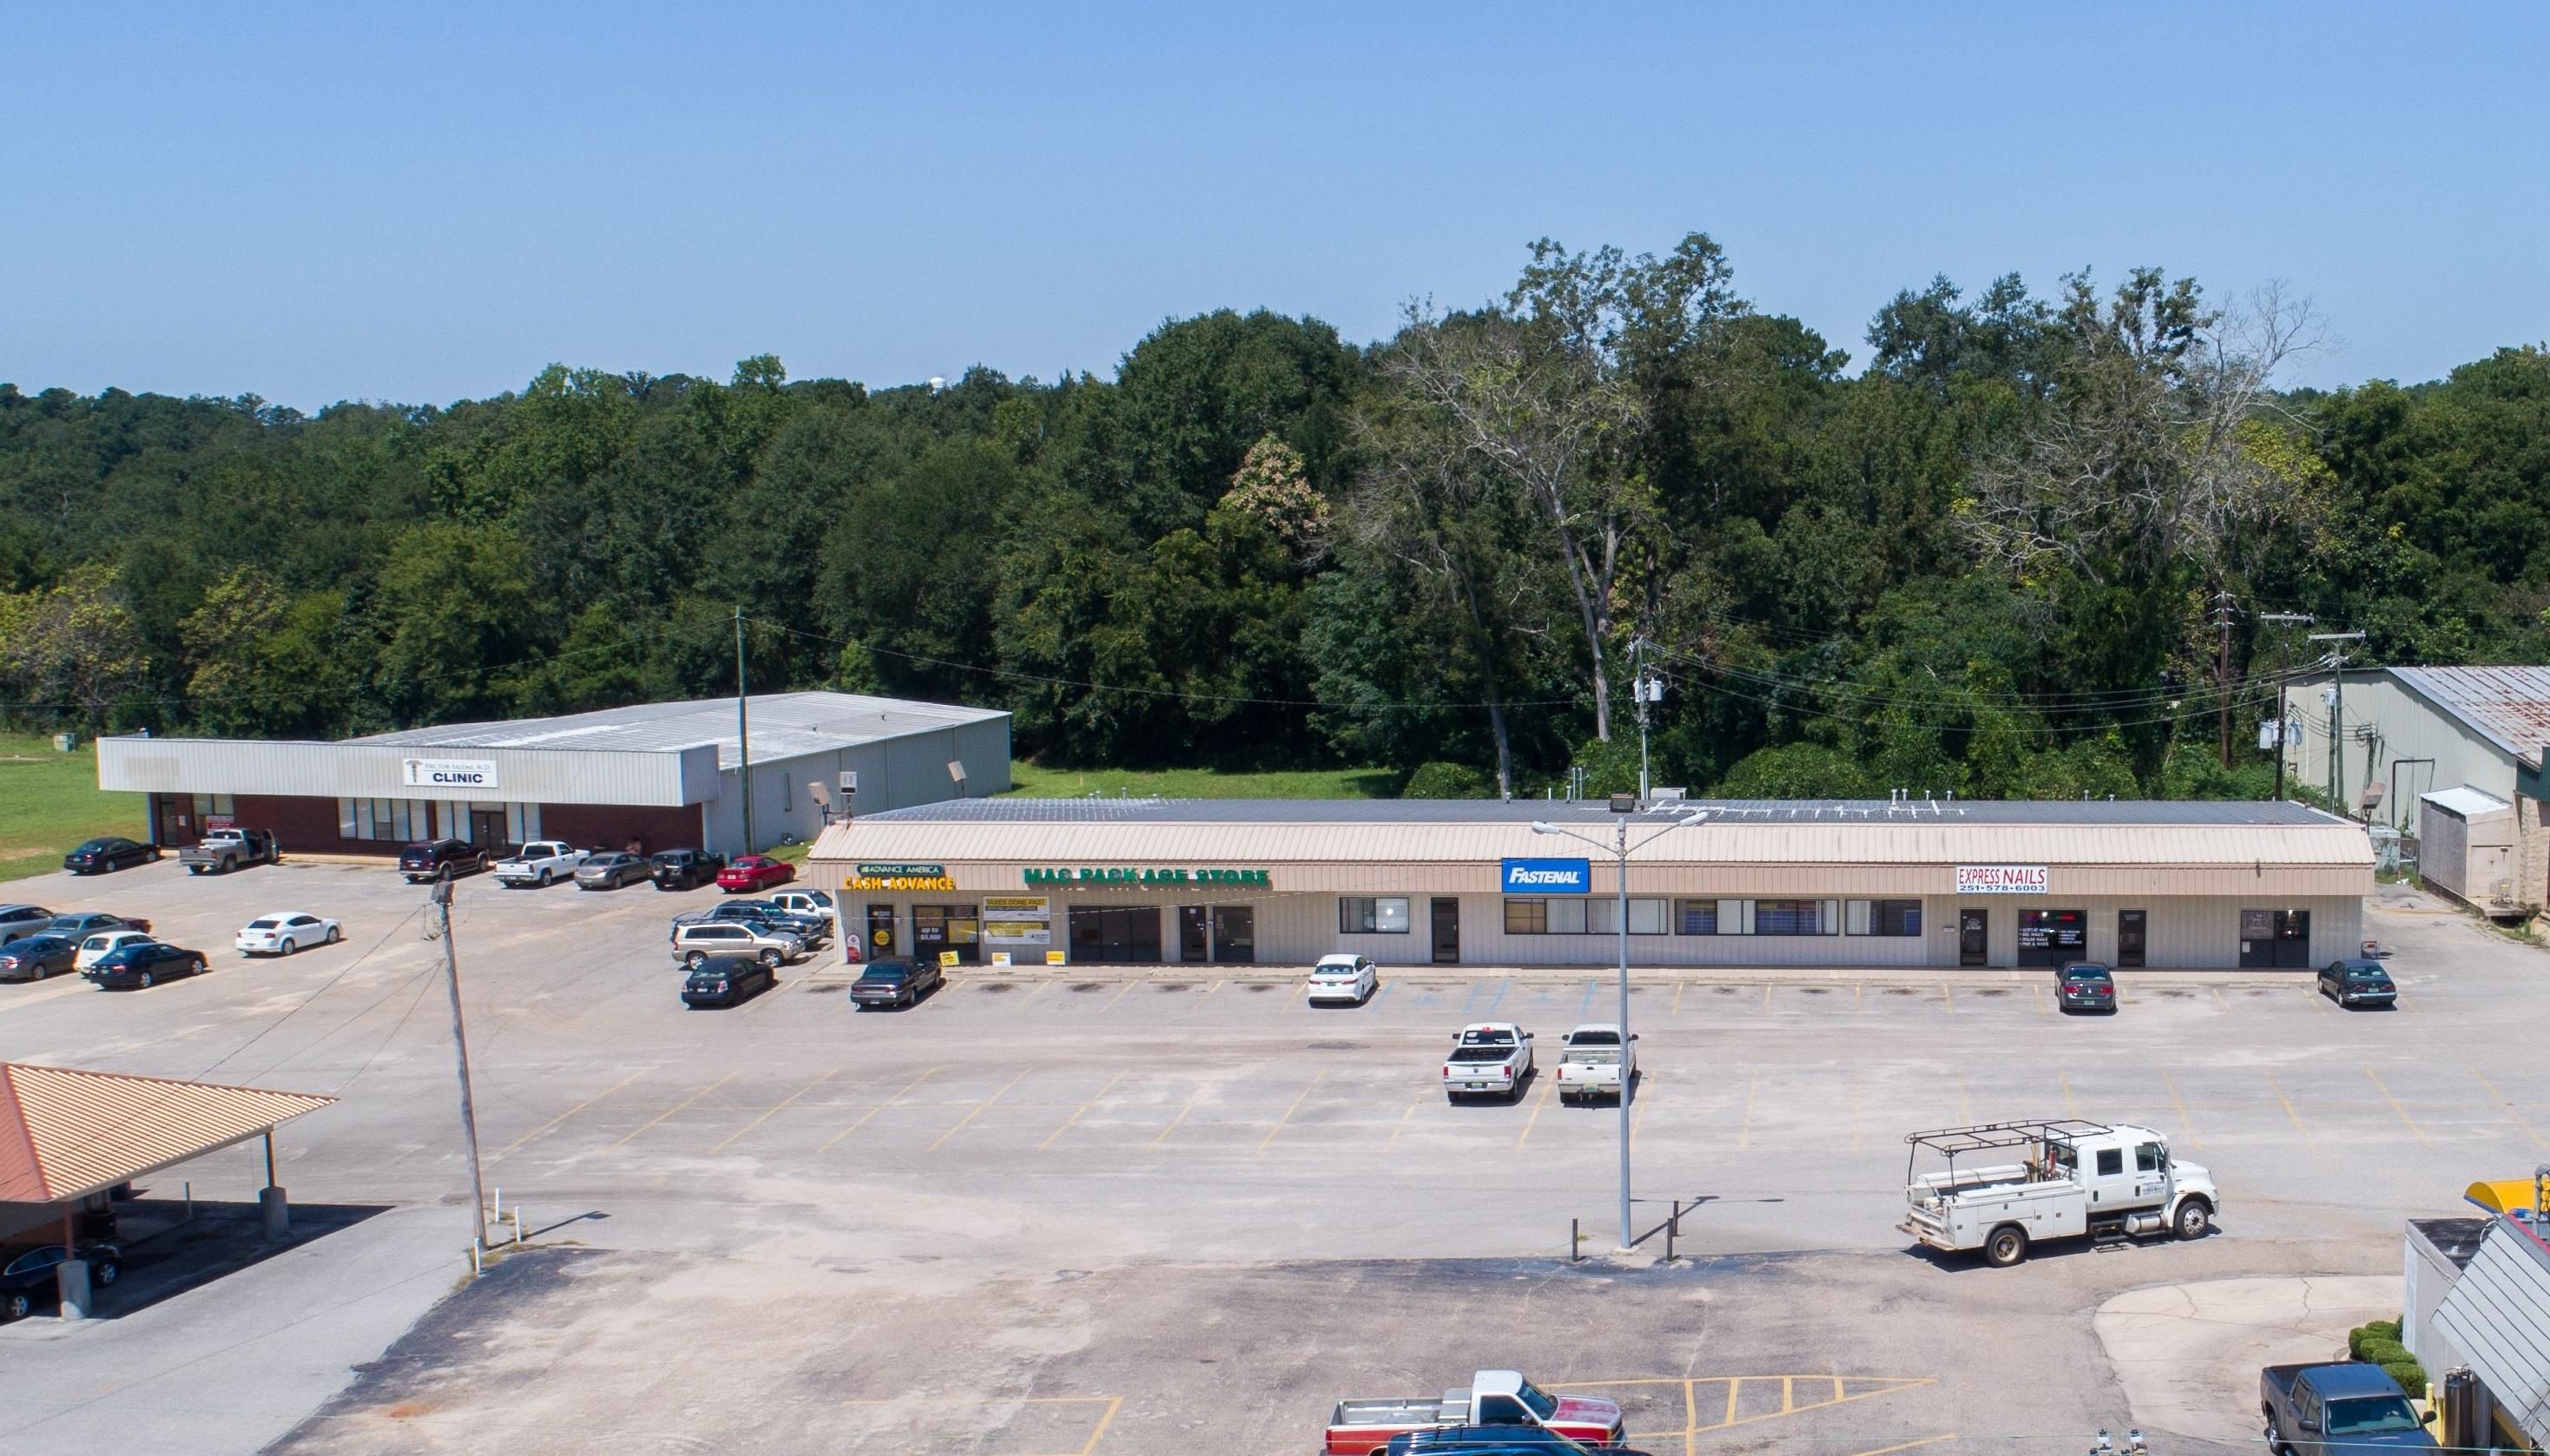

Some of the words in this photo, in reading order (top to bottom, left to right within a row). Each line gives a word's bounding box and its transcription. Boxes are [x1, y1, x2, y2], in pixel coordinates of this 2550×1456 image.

[432, 773, 484, 783] CLINIC
[845, 877, 882, 889] CASH
[888, 877, 953, 890] ADVANCE
[1196, 869, 1269, 886] STORE
[1959, 869, 2000, 884] EXPRESS
[2003, 869, 2046, 884] NAILS
